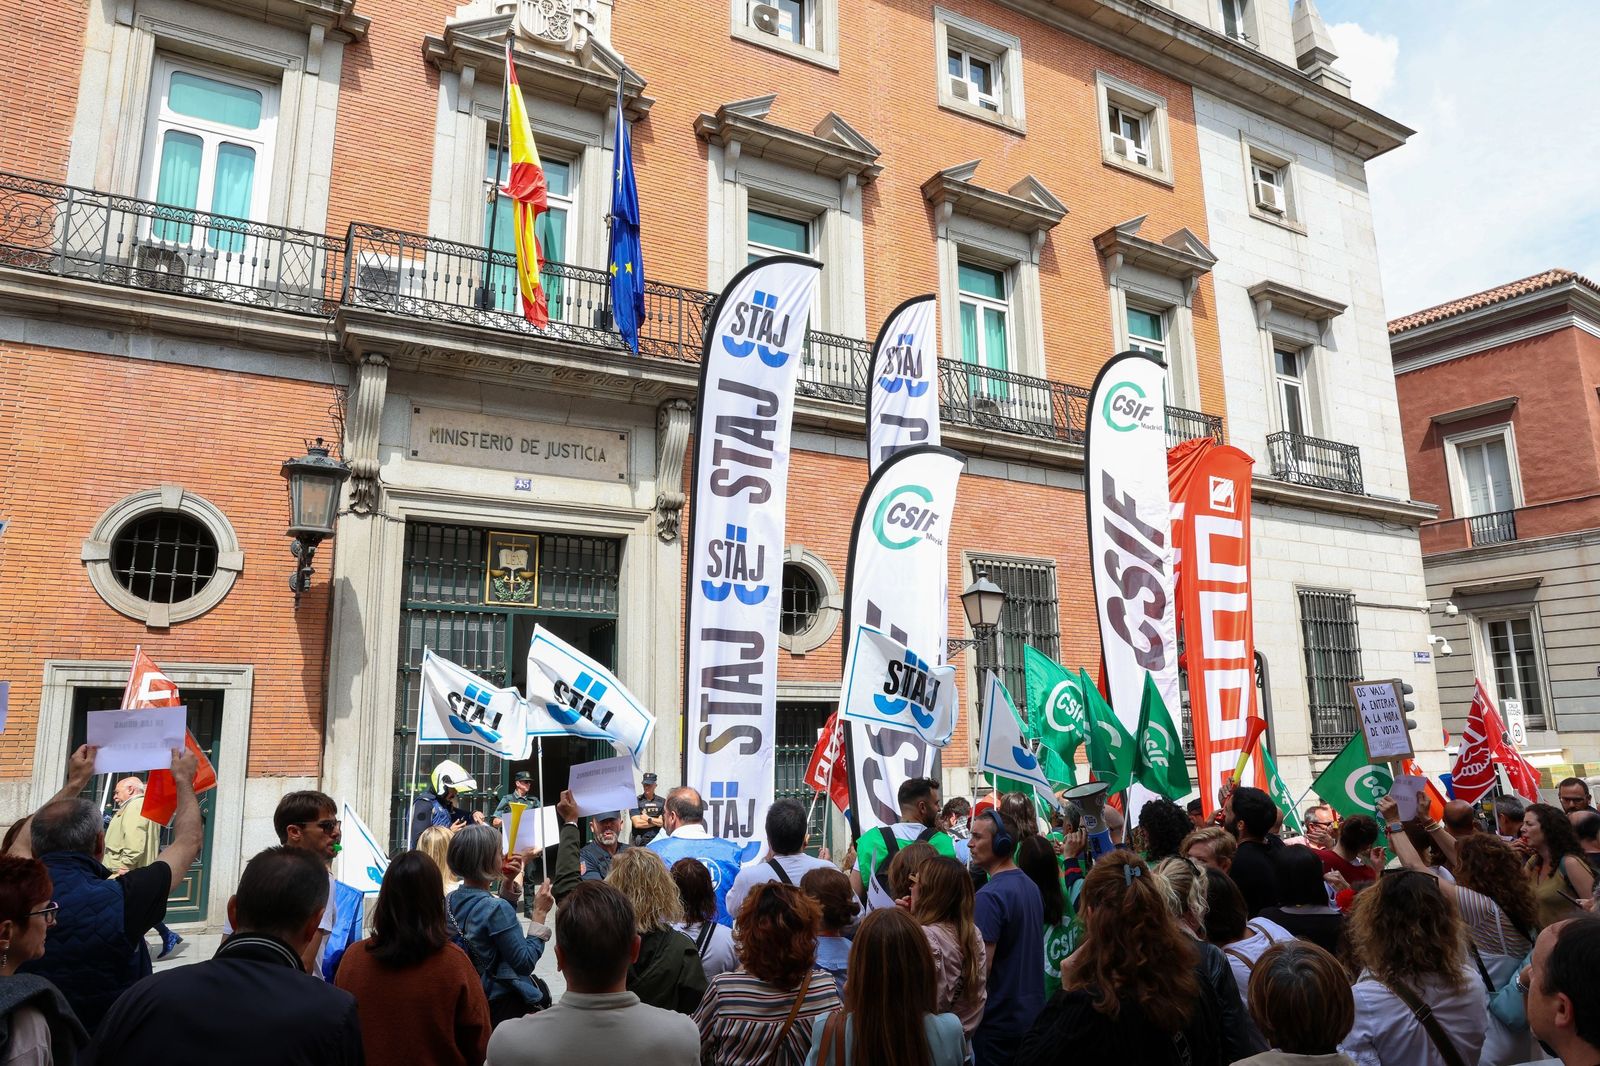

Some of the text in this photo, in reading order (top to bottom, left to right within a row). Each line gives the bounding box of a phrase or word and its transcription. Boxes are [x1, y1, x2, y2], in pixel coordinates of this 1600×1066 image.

[730, 301, 790, 348] STAJ
[882, 345, 924, 380] STAJ
[1112, 394, 1154, 421] CSIF
[709, 378, 779, 504] STAJ
[1140, 422, 1163, 431] Madrid
[429, 427, 607, 463] MINISTERIO DE JUSTICIA
[515, 479, 530, 490] 45
[887, 502, 939, 532] CSIF
[707, 538, 765, 582] STAJ
[1101, 469, 1167, 671] CSIF
[699, 628, 765, 756] STAJ
[883, 659, 941, 712] STAJ
[1356, 686, 1386, 697] OS VAIS
[1361, 697, 1397, 711] A ENTERAR
[1364, 711, 1399, 724] A LA HORA
[1370, 724, 1400, 737] DE VOTAR
